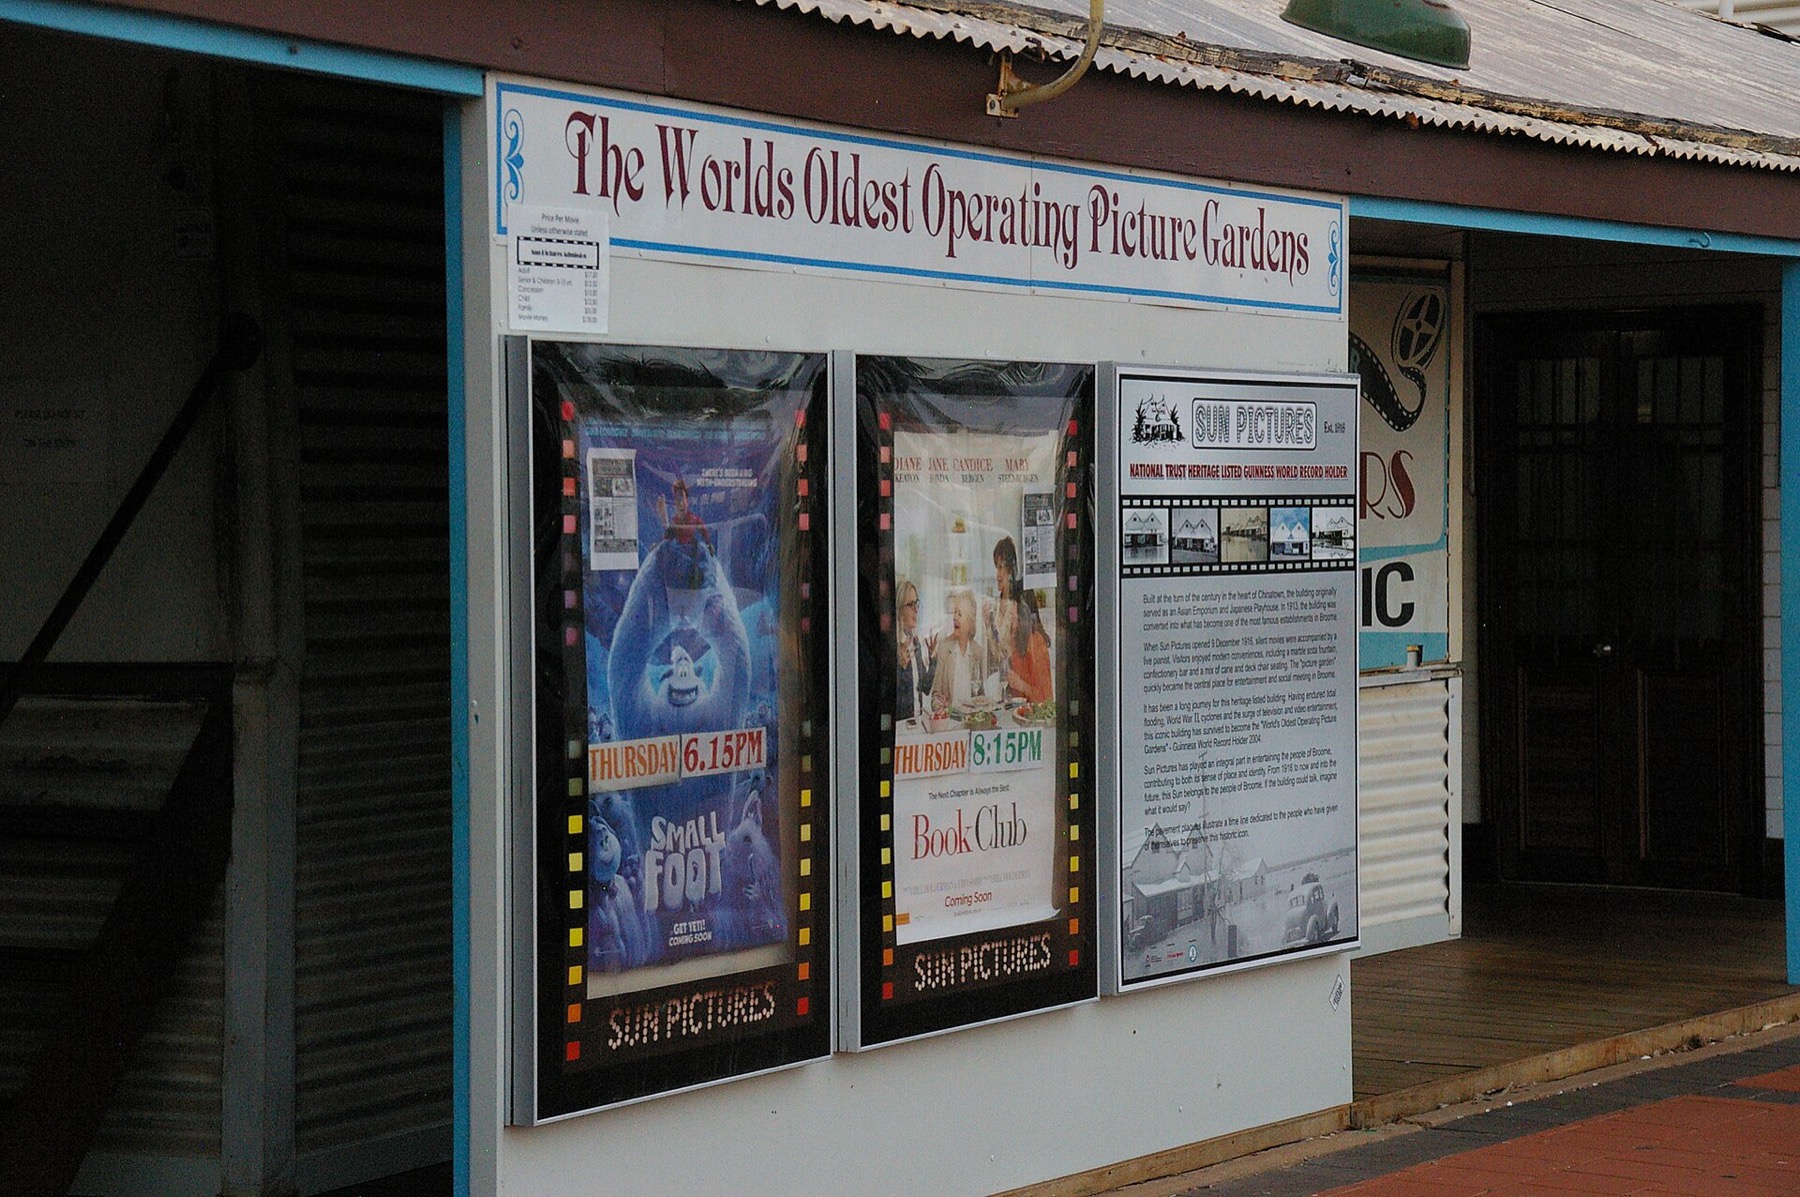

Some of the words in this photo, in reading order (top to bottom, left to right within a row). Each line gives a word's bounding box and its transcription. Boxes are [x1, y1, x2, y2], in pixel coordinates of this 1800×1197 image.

[565, 110, 645, 216] The
[656, 124, 795, 220] Worlds
[804, 147, 914, 234] Oldest
[922, 162, 1081, 270] Operating
[1087, 184, 1196, 262] Picture
[1202, 199, 1310, 287] Gardens
[1195, 406, 1231, 443] SUN
[1237, 406, 1314, 444] PICTURES
[1130, 463, 1164, 478] NATIONAL
[1165, 464, 1187, 478] TRUST
[1187, 464, 1220, 478] HERITAGE
[1221, 464, 1242, 478] LISTED
[1244, 465, 1275, 478] GUINNESS
[1276, 465, 1298, 478] WORLD
[1299, 465, 1324, 478] RECORD
[1324, 466, 1348, 478] HOLDER
[590, 741, 678, 781] THURSDAY
[684, 730, 762, 772] 6.15PM
[894, 739, 969, 775] THURSDAY
[972, 730, 1042, 766] 8:15PM
[651, 811, 726, 854] SMALL
[911, 808, 973, 860] Book
[975, 802, 1027, 851] Club
[644, 842, 722, 913] FOOT
[944, 893, 973, 908] Coming
[974, 891, 992, 904] Soon
[669, 934, 694, 946] COMING
[694, 931, 713, 943] SOON
[673, 922, 687, 935] GET
[688, 919, 706, 932] YETI!
[914, 951, 955, 992] SUN
[960, 931, 1051, 983] PICTURES
[608, 1004, 659, 1050] SUN
[666, 980, 777, 1039] PICTURES
